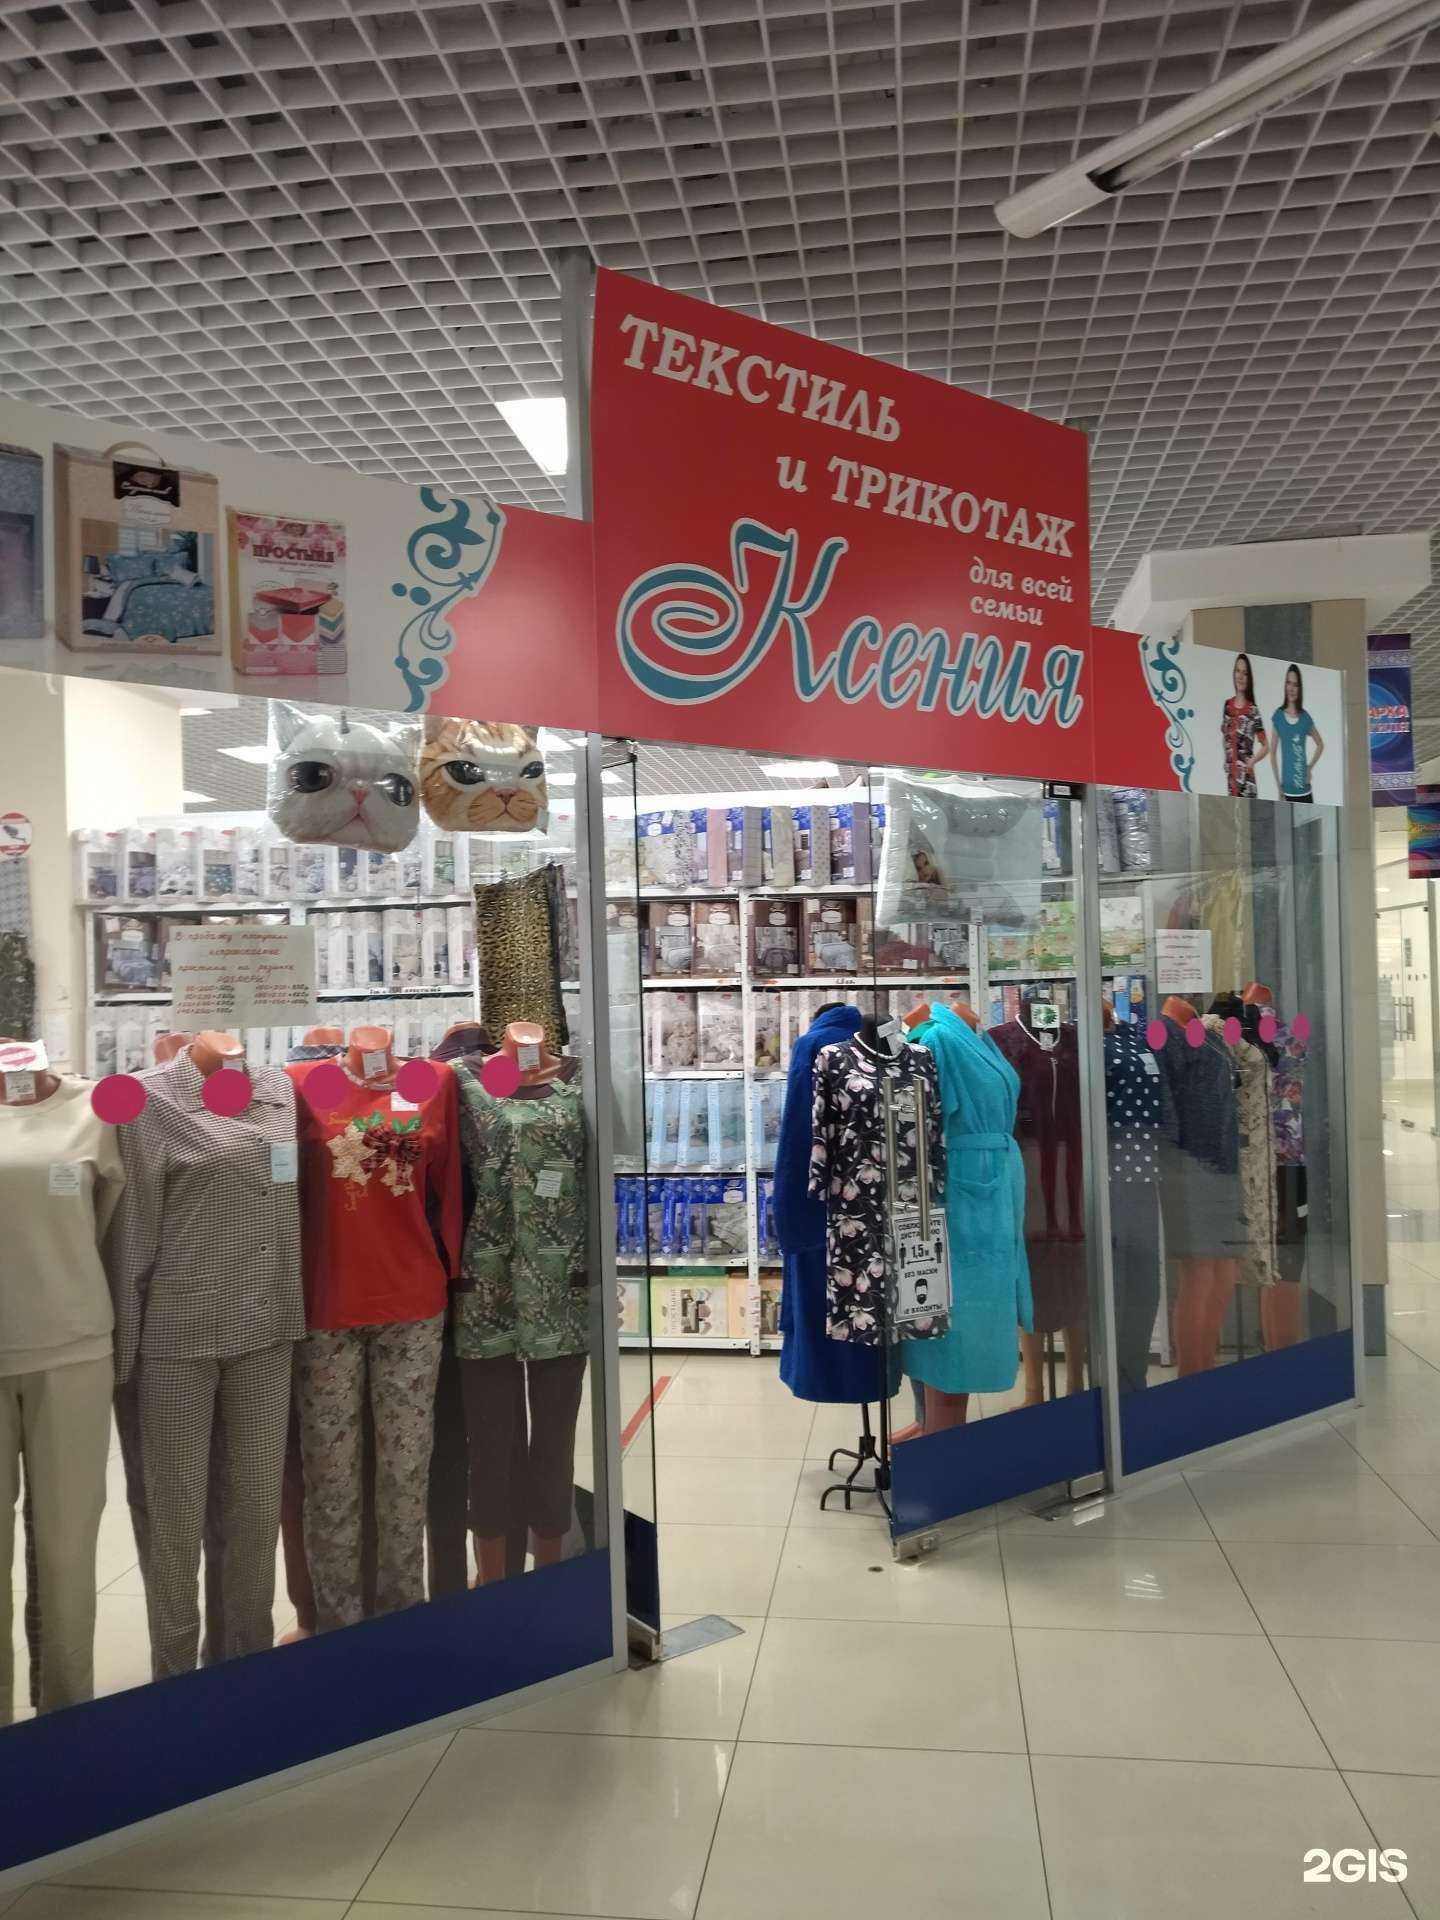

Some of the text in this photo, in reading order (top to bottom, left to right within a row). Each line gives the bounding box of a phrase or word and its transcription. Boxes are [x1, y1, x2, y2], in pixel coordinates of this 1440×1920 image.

[619, 314, 901, 442] ТЕКСТИЛЬ
[776, 455, 1075, 559] и ТРИКОТАЖ
[615, 516, 1084, 728] Ксения
[969, 556, 1073, 603] для всей
[970, 594, 1043, 626] семьи
